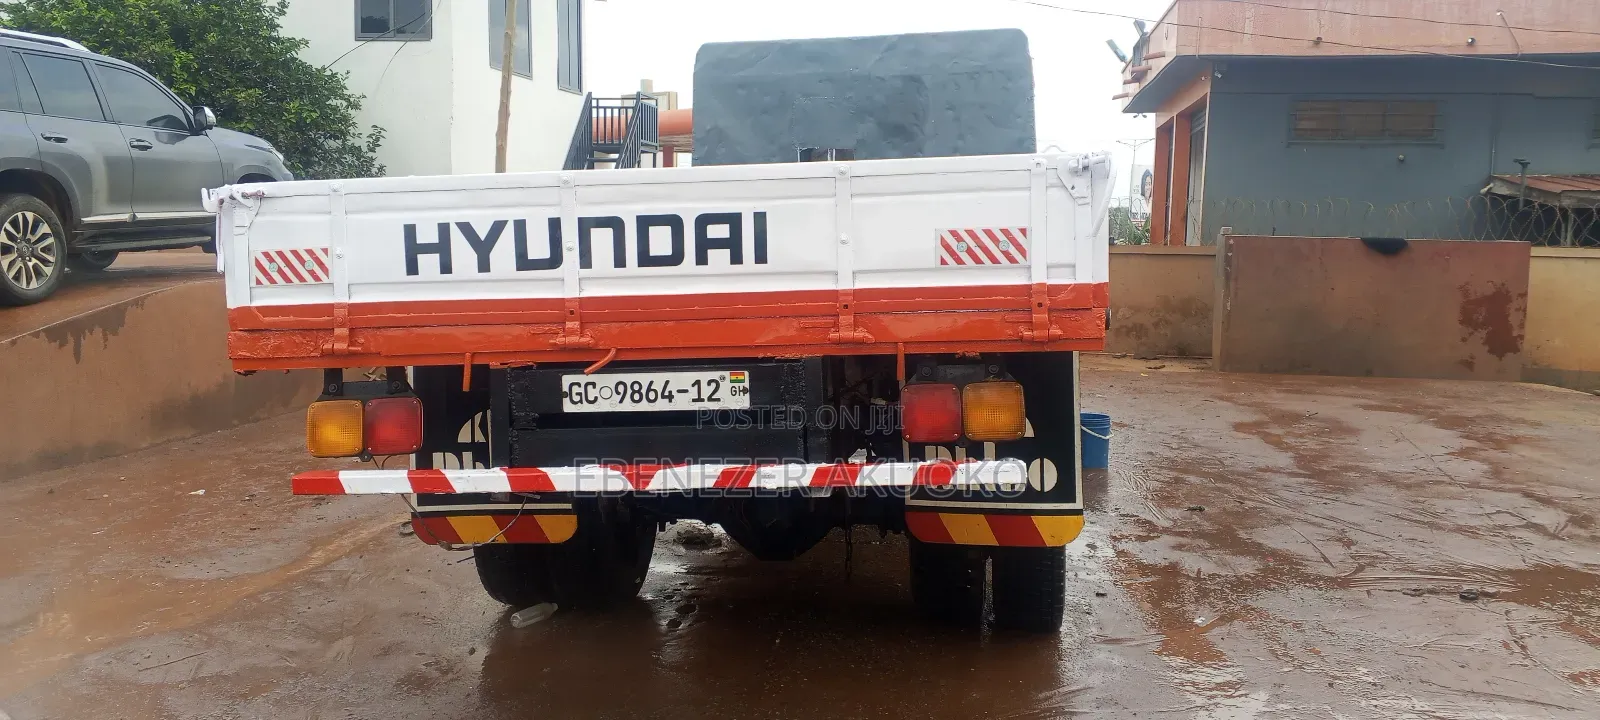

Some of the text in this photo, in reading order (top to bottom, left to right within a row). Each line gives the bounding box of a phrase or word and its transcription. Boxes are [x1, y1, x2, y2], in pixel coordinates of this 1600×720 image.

[403, 211, 768, 276] HYUNDAI
[568, 382, 598, 405] GC
[614, 379, 721, 404] 9864-12
